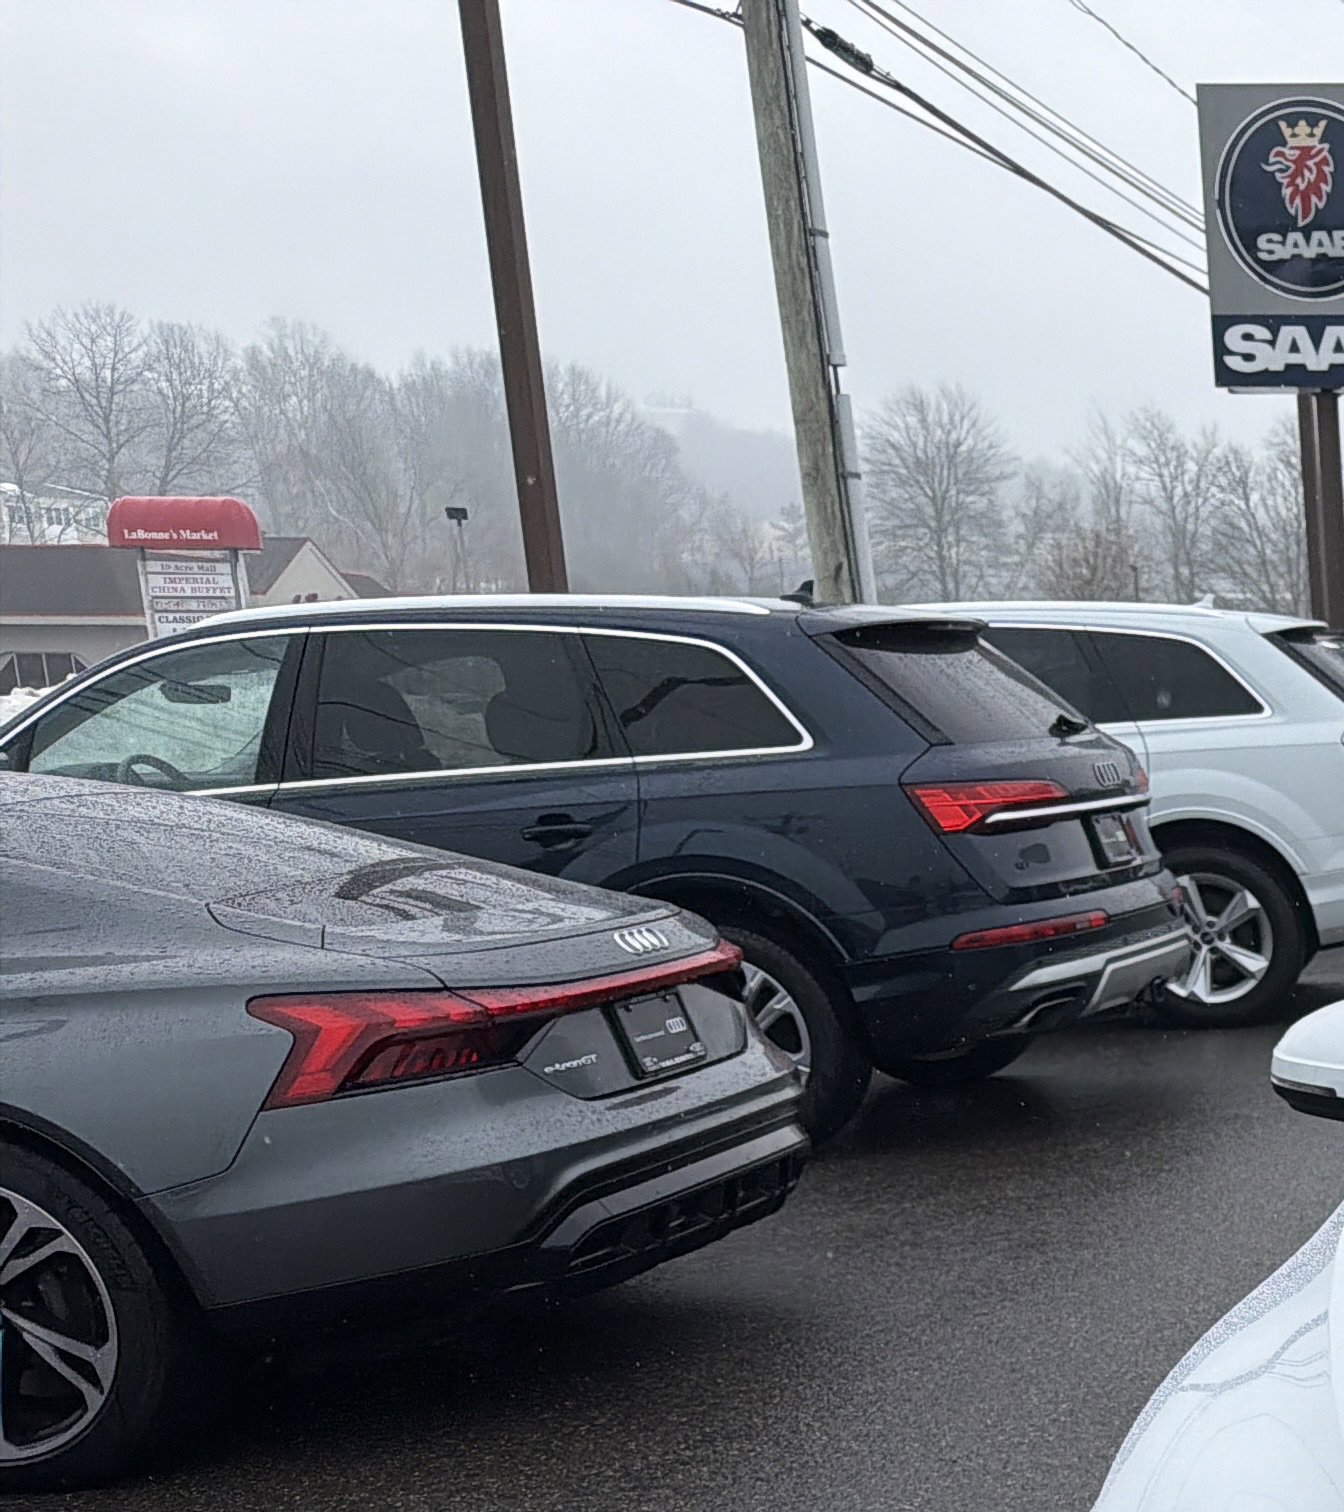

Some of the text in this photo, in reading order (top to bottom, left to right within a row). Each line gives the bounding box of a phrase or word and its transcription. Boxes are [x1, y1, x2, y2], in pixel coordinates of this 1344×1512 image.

[123, 528, 219, 541] LaBonne's Market
[173, 563, 194, 571] Acre
[196, 563, 217, 572] Mall
[162, 576, 219, 585] IMPERIAL
[151, 586, 233, 594] CHINA BUFFET
[581, 1053, 598, 1065] GT
